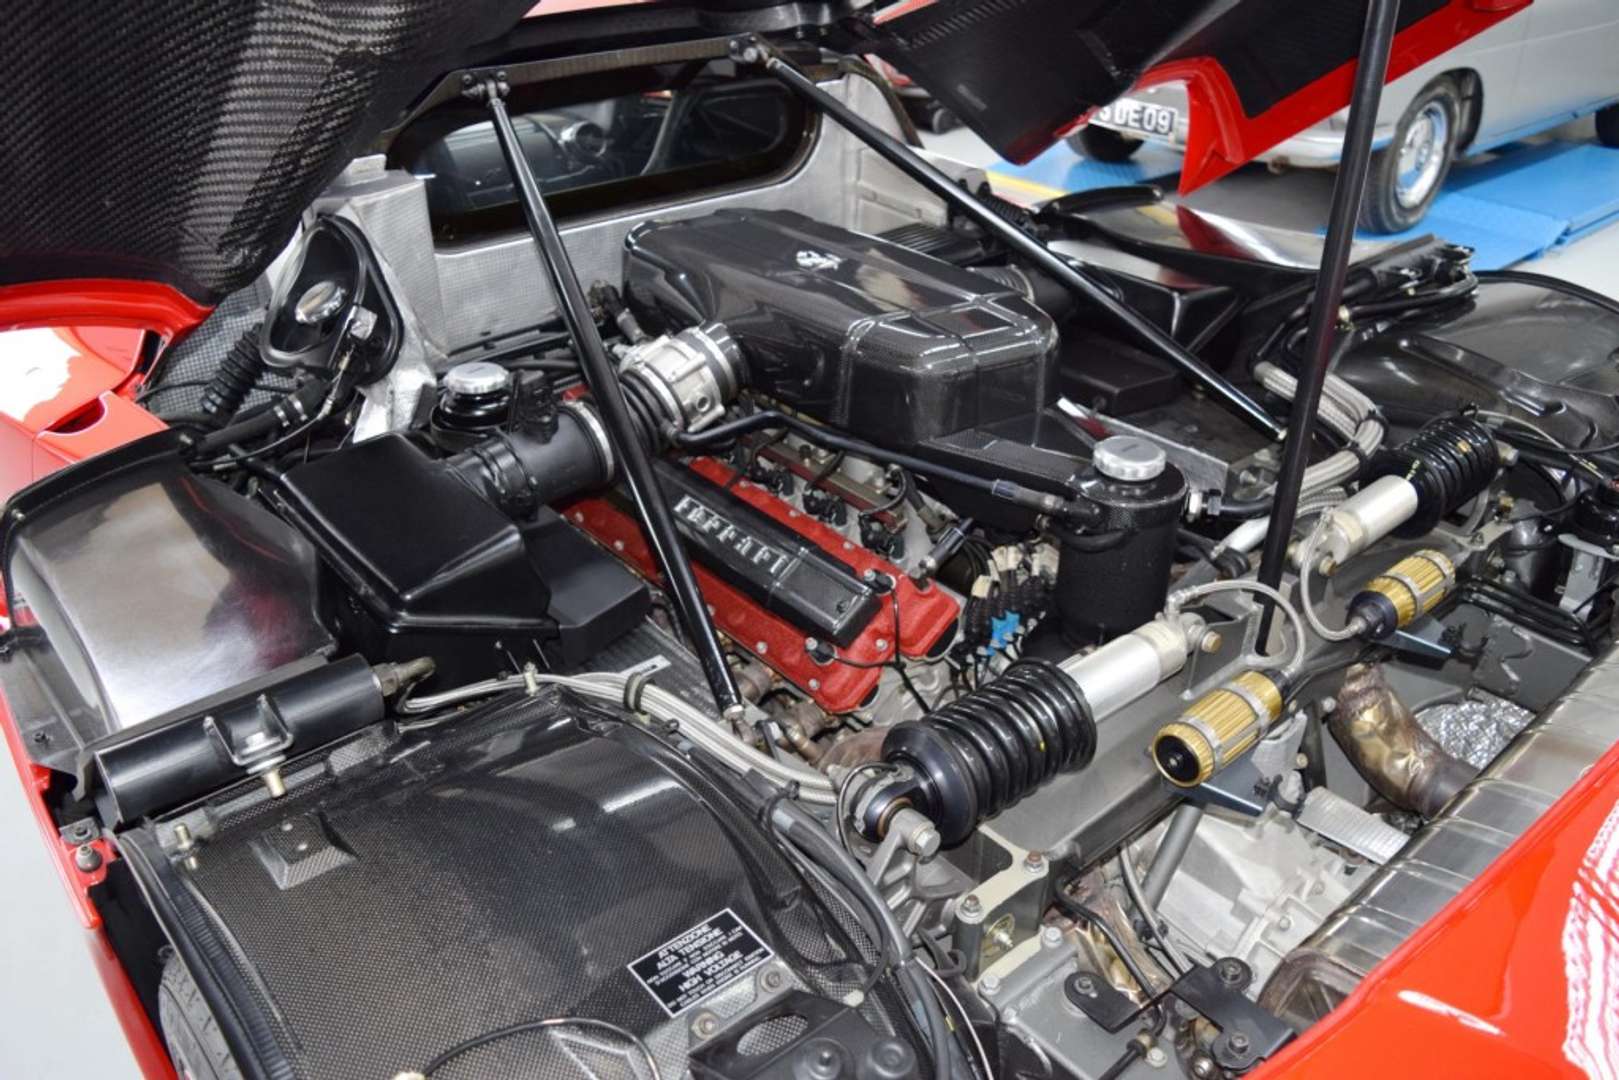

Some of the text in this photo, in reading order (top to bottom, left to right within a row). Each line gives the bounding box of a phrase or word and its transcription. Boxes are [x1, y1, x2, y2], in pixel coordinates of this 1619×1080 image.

[655, 952, 679, 970] ALTA
[679, 927, 724, 957] TENSIONE
[657, 923, 712, 959] ATTENZIONE
[678, 974, 703, 992] HIGH
[703, 949, 743, 977] VOLTAGE
[682, 950, 725, 978] WARNING
